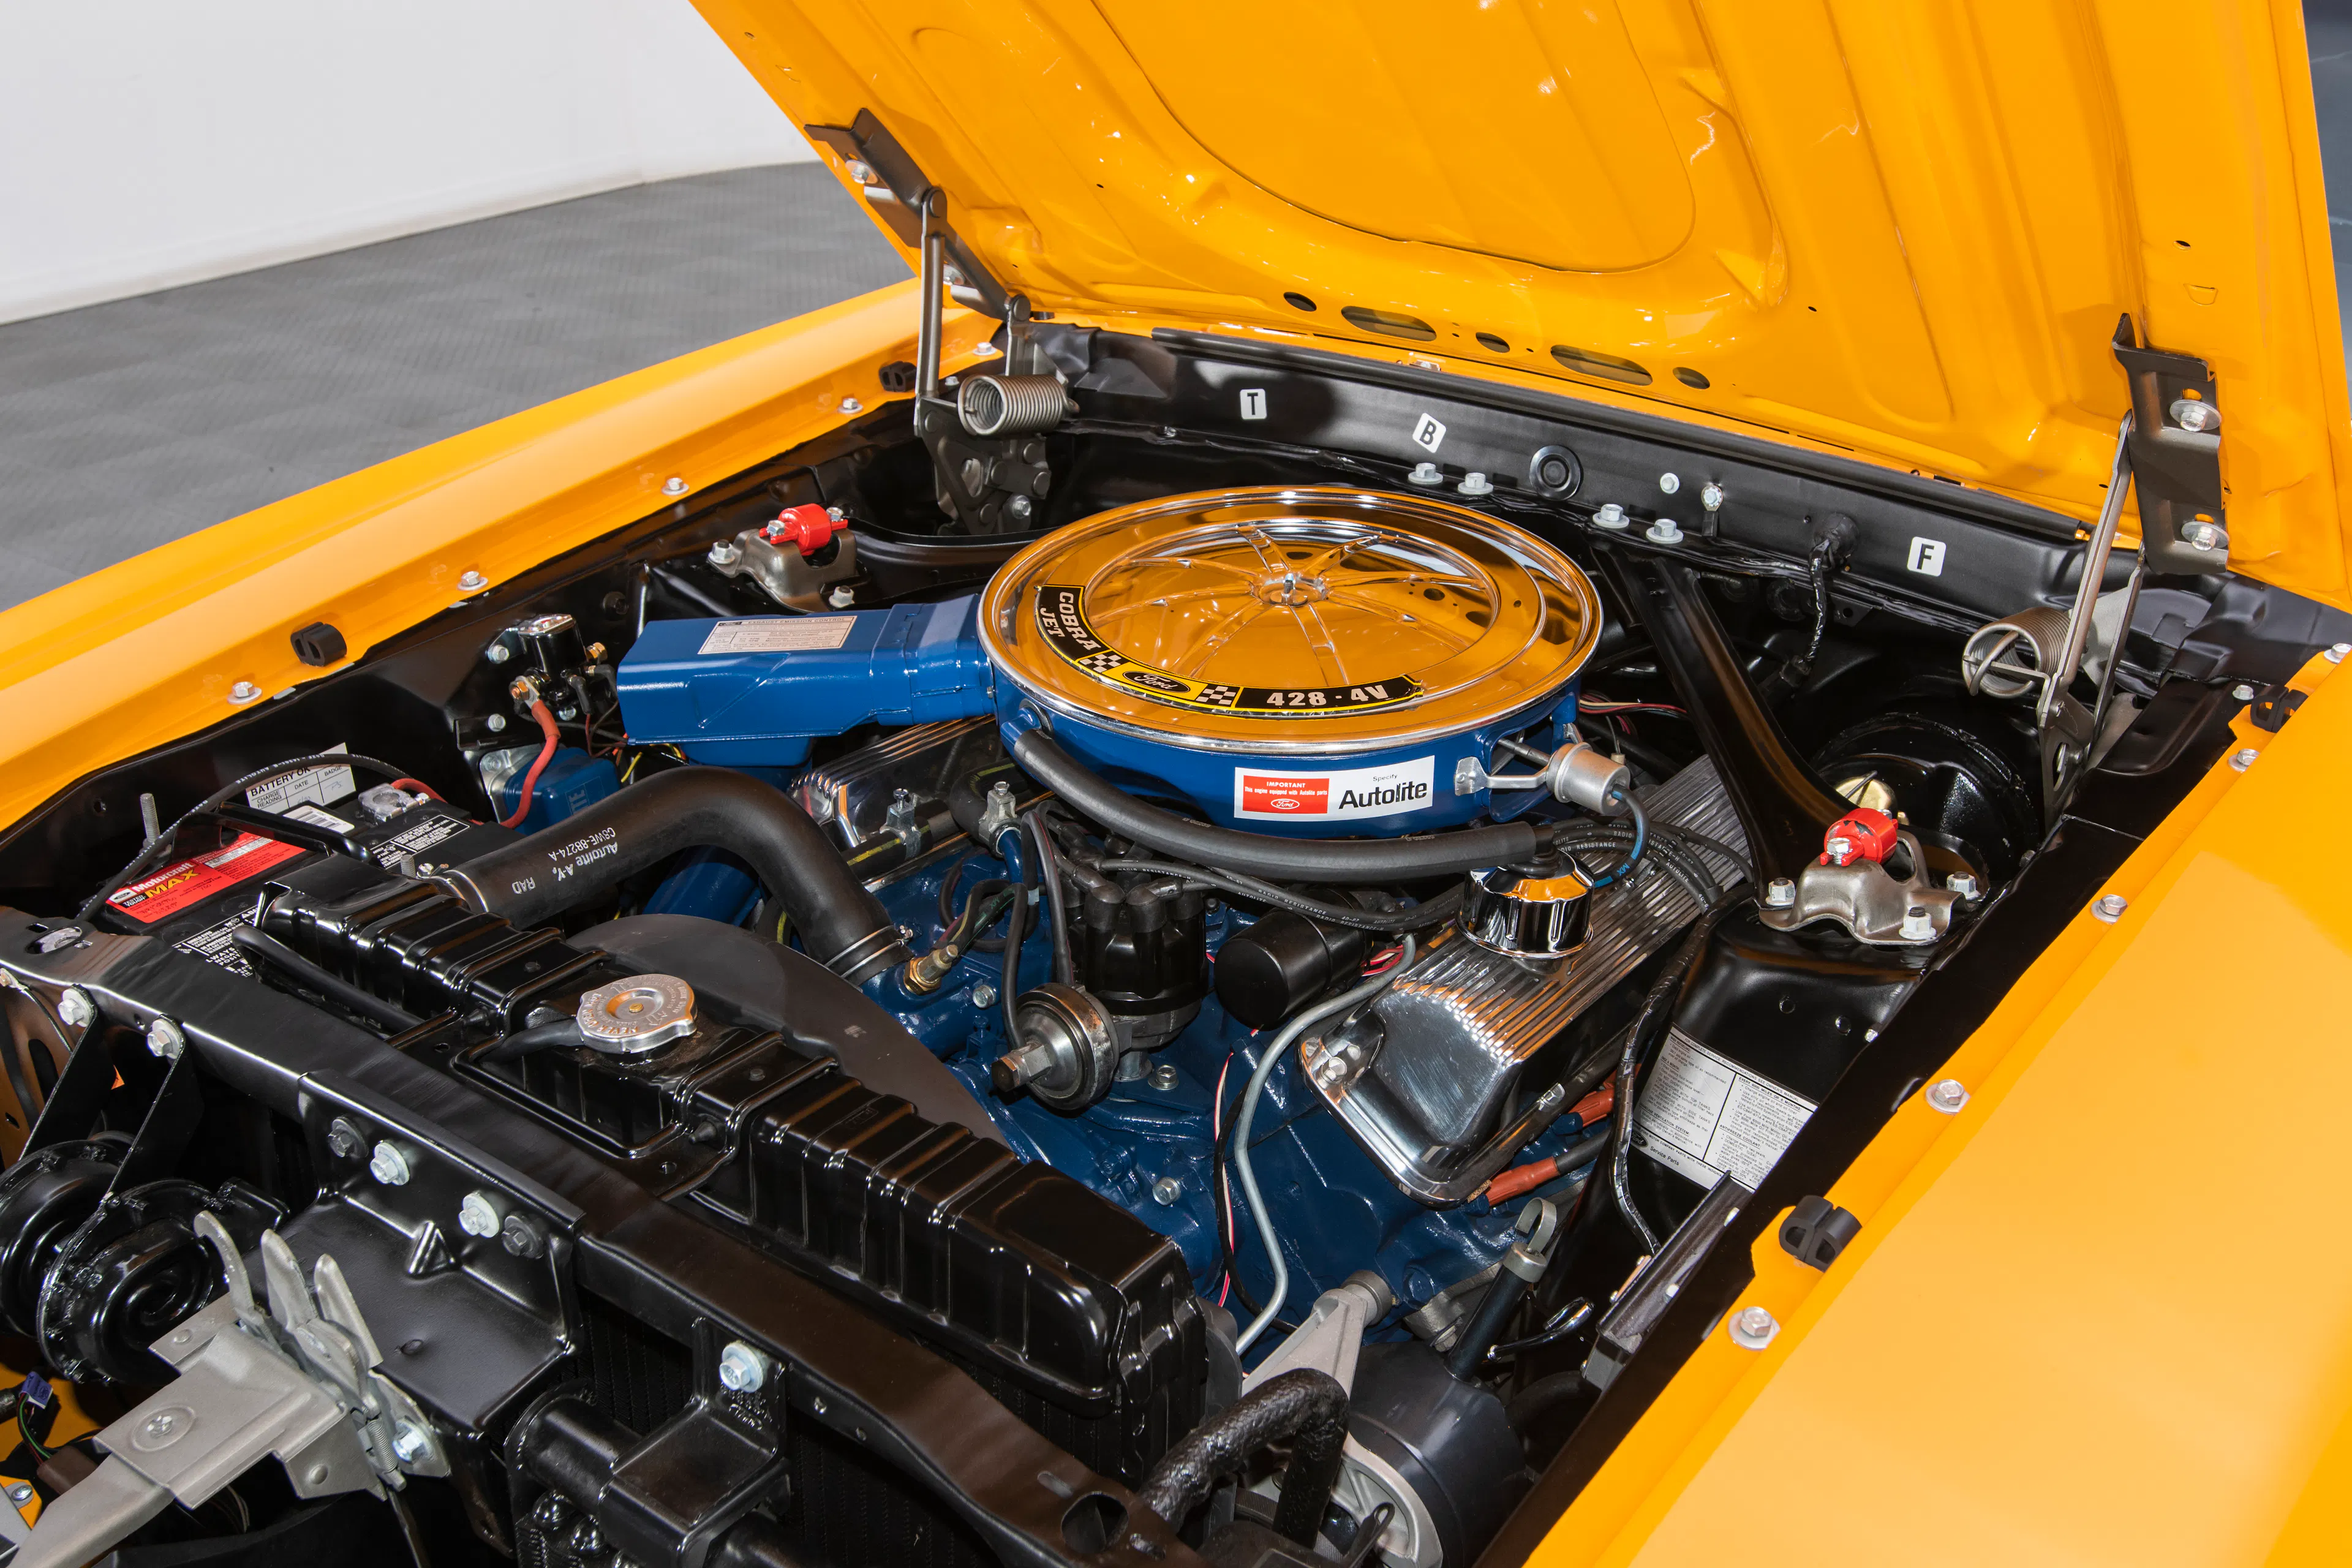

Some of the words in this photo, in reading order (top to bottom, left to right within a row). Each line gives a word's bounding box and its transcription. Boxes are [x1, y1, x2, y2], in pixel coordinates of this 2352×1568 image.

[1246, 393, 1259, 415] T
[1419, 420, 1436, 445] B
[1917, 543, 1935, 570] F
[1040, 608, 1065, 637] JET
[1059, 592, 1101, 650] COBRA
[1134, 674, 1177, 690] Ford
[1267, 692, 1327, 706] 428
[1351, 685, 1389, 701] 4V
[324, 765, 342, 777] BADGE
[1373, 774, 1398, 782] Specify
[251, 772, 294, 797] BATTERY
[296, 766, 311, 776] OK
[294, 780, 309, 790] DATE
[257, 790, 280, 804] CHARGE
[257, 795, 282, 809] READING
[1273, 799, 1295, 809] Ford
[1338, 781, 1427, 810] Autolite
[548, 827, 616, 861] C8WE-8B274-A
[575, 842, 618, 867] Autolite
[130, 862, 194, 893] Motorcraft
[1616, 862, 1630, 876] MX
[1665, 861, 1689, 883] AUTOLITE
[146, 869, 200, 898] MAX
[511, 876, 536, 894] RAD
[123, 894, 144, 906] TESTED
[126, 897, 145, 908] TOUGH
[1238, 892, 1266, 902] AUTOLITE
[1258, 889, 1278, 899] RADIO
[1284, 899, 1327, 914] RESISTANCE
[1340, 921, 1384, 930] RESISTANCE-H
[205, 947, 235, 963] LWAYS
[597, 1026, 639, 1035] NEVER
[1722, 1060, 1757, 1080] RECOMMENDATIONS
[1766, 1082, 1782, 1093] OWNER'S
[1784, 1091, 1799, 1102] MANUAL
[1719, 1124, 1741, 1137] ANTIFREEZE
[1649, 1145, 1667, 1158] Service
[1667, 1155, 1679, 1166] Parts
